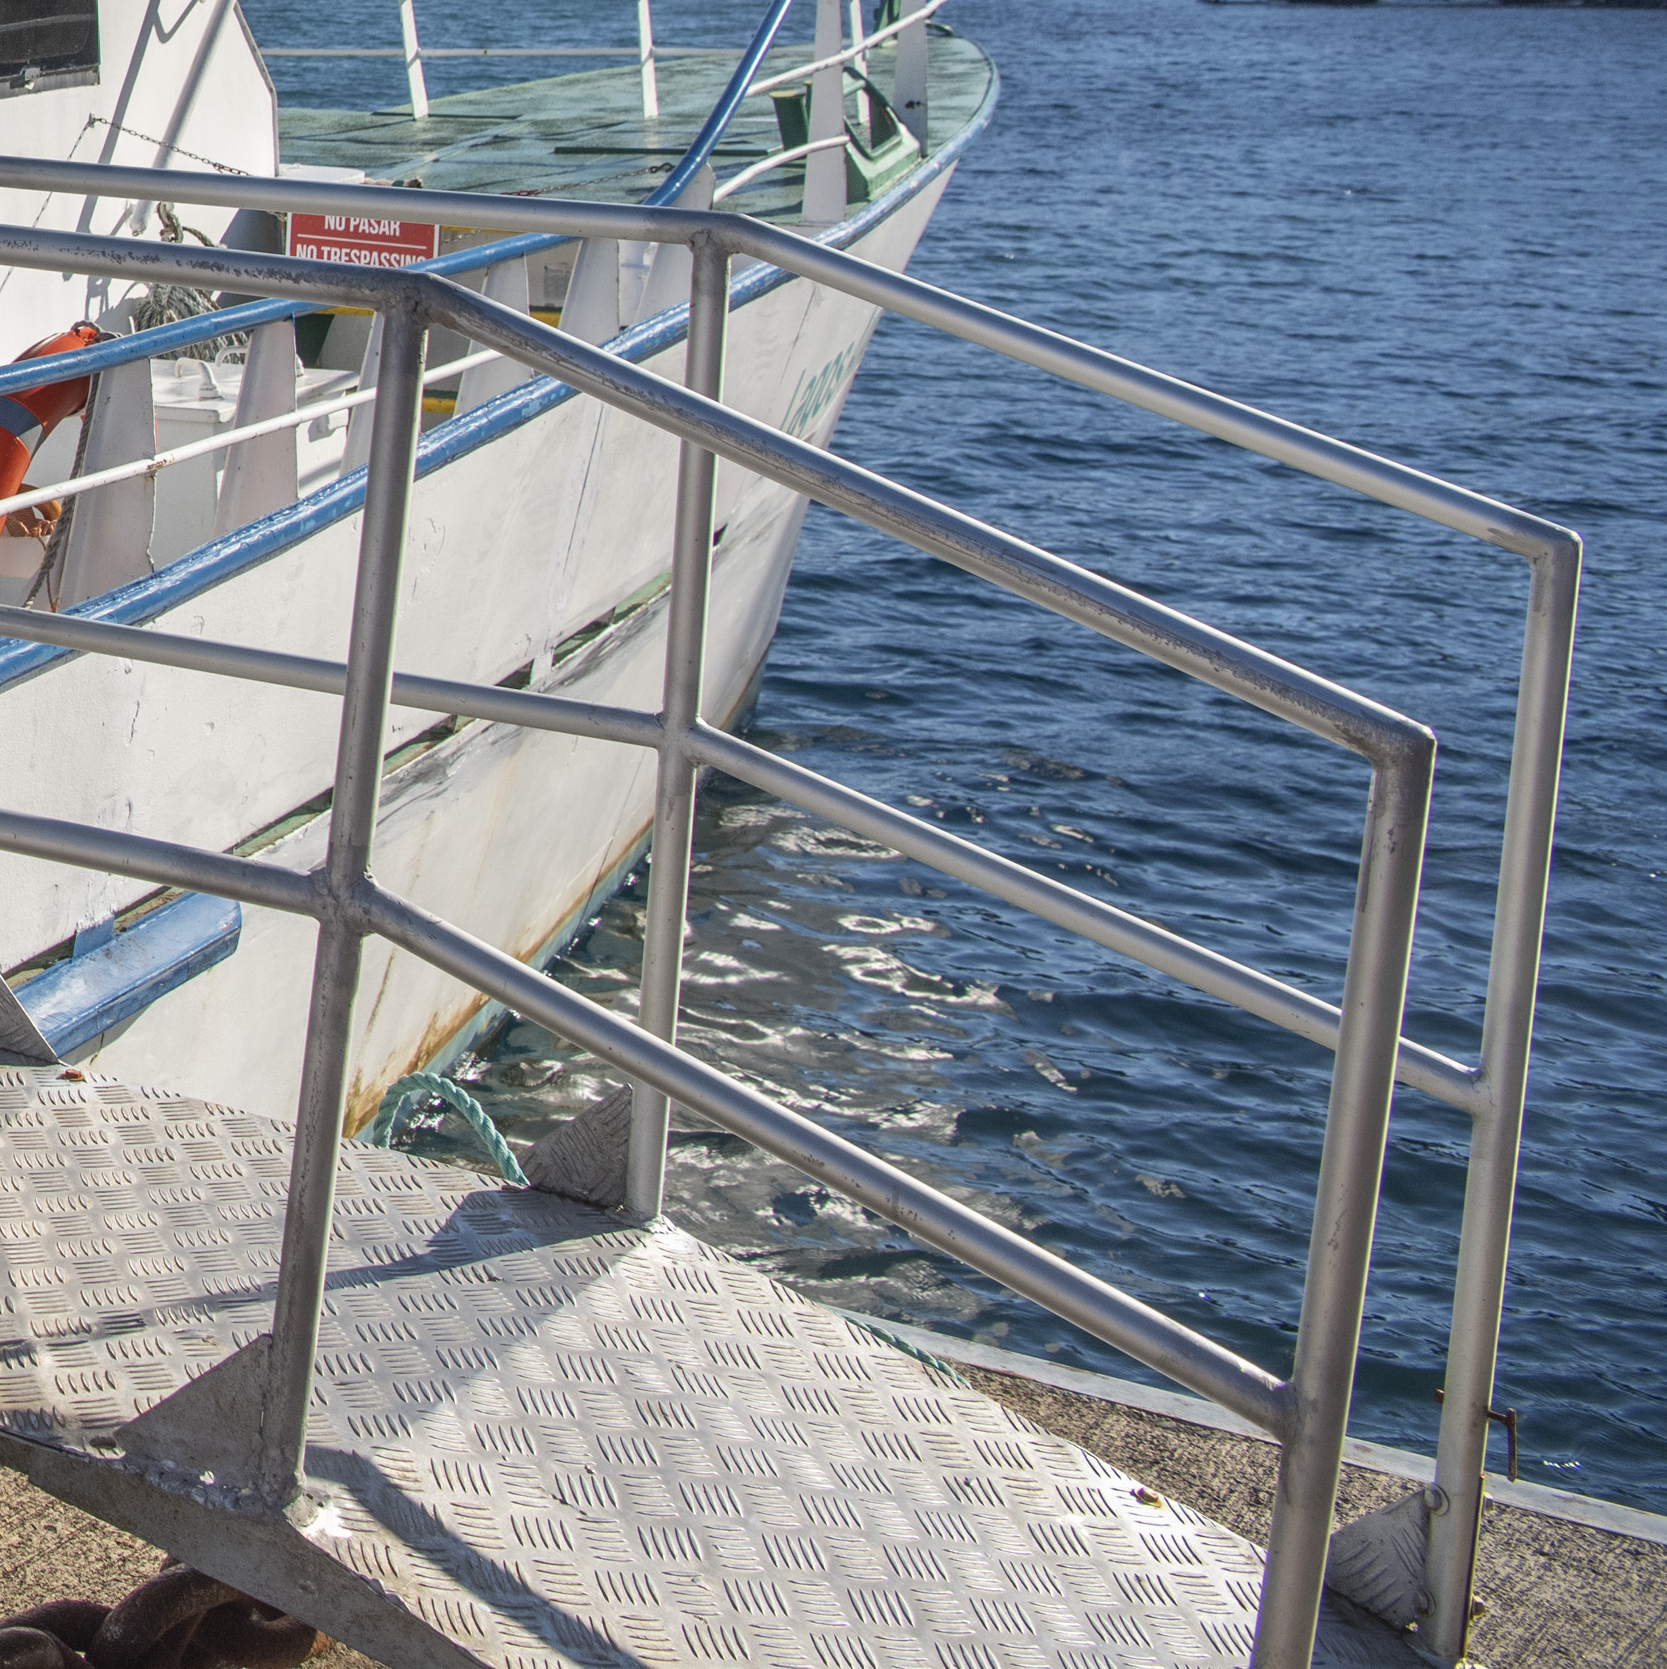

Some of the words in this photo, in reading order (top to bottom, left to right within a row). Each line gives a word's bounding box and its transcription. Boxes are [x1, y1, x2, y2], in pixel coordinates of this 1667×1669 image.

[324, 215, 345, 231] NO
[349, 217, 400, 237] PASAR
[296, 244, 317, 260] NO
